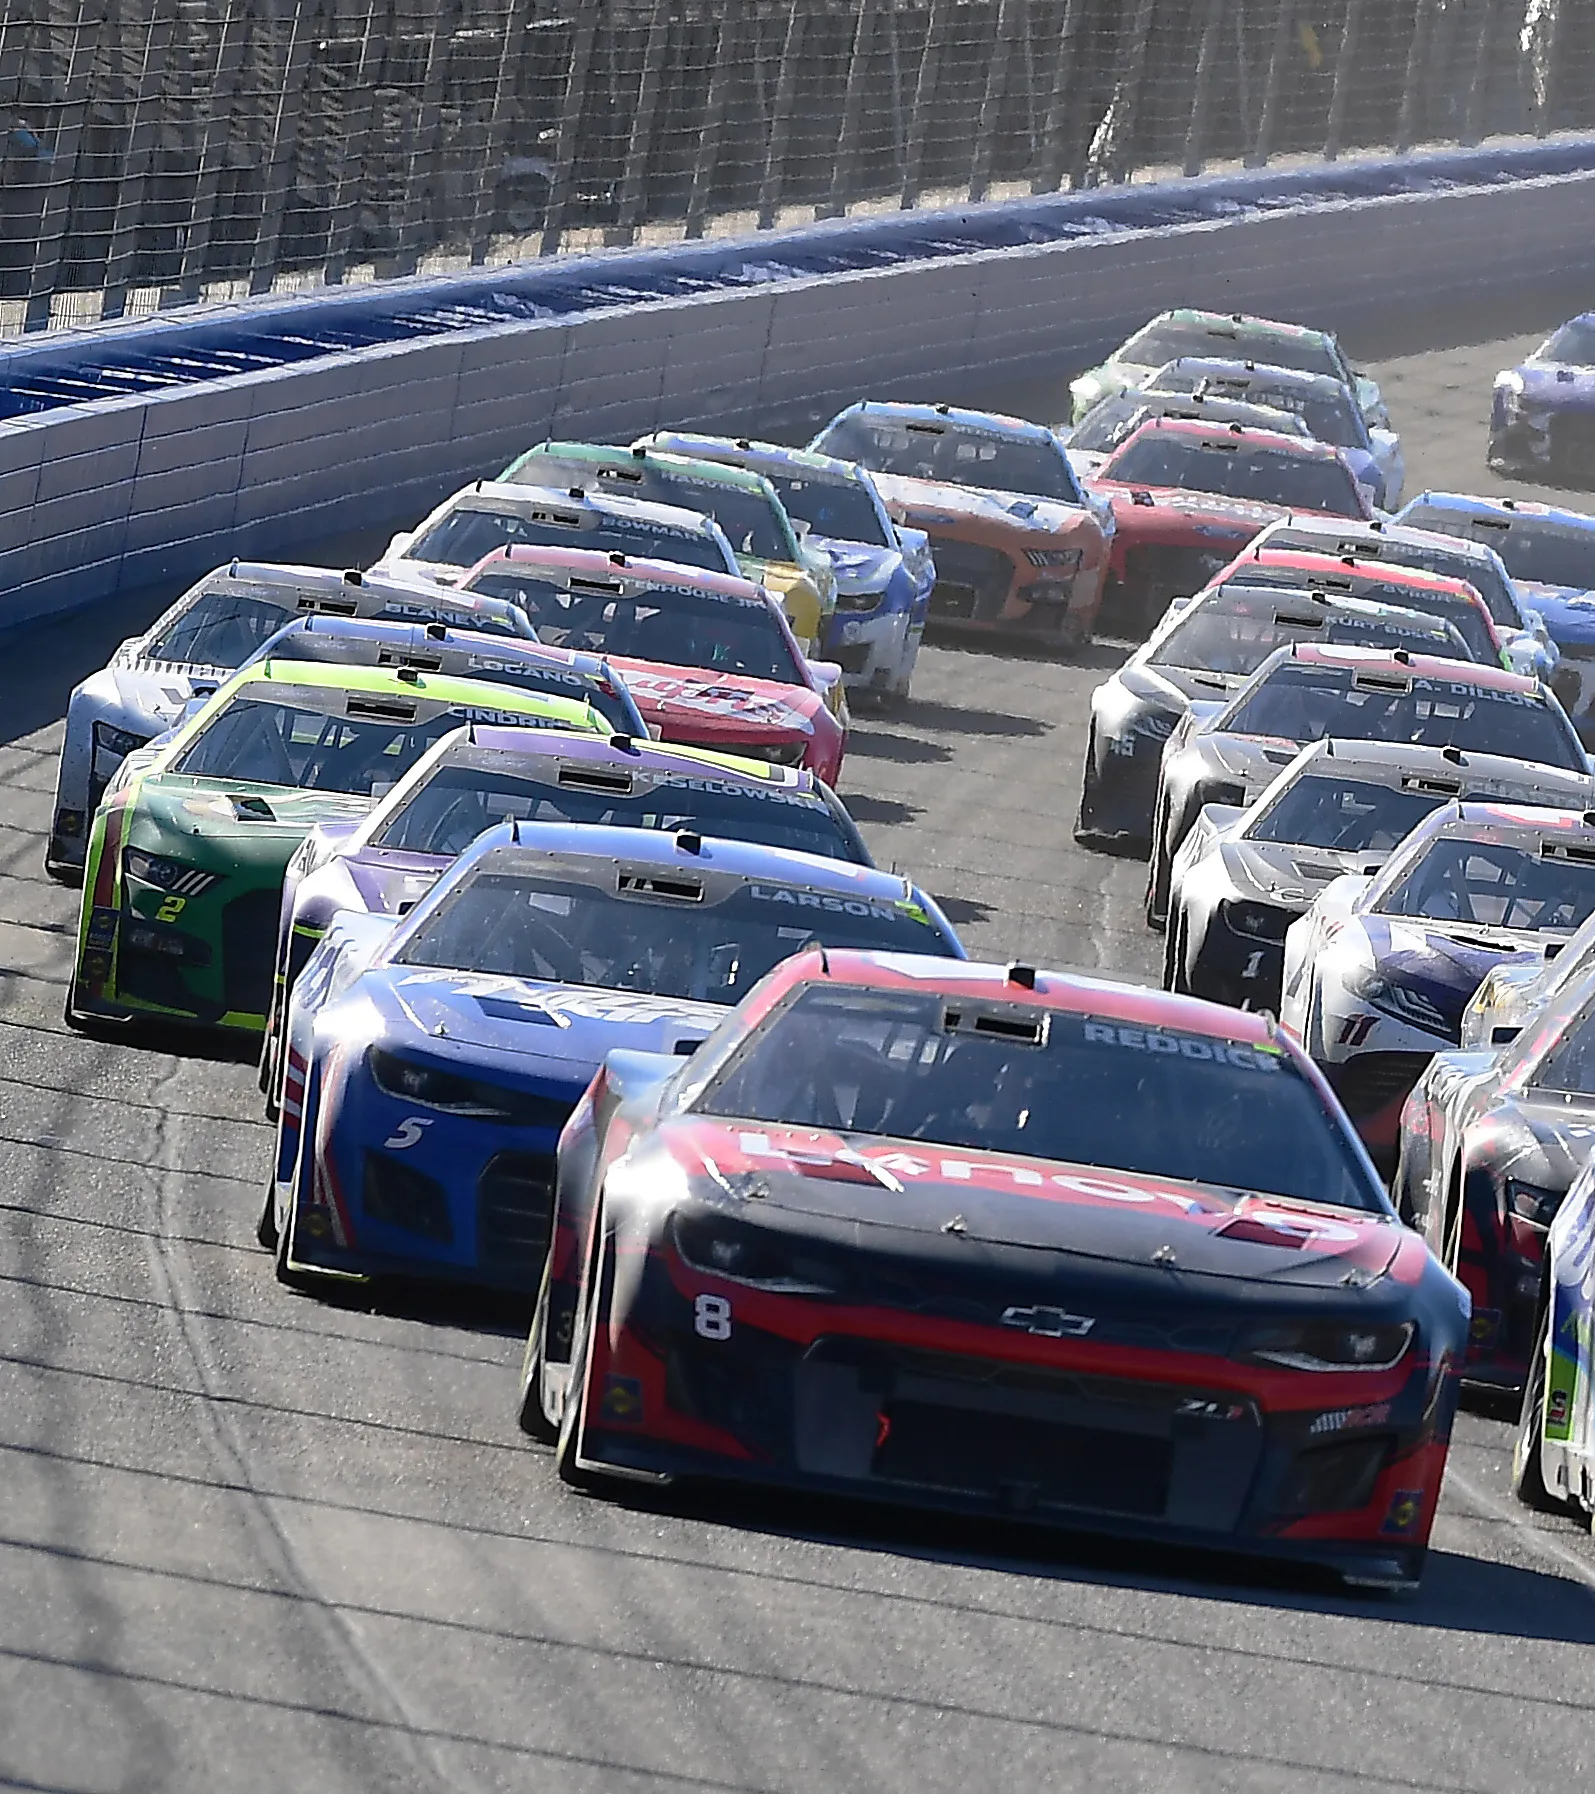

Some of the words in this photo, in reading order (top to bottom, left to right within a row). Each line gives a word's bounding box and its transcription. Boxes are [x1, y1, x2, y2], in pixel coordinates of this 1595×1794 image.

[384, 602, 490, 628] BLANEY
[467, 656, 582, 687] LOGANO
[154, 895, 188, 923] 2
[751, 886, 896, 923] LARSON
[1241, 950, 1265, 980] 1
[383, 1115, 434, 1150] 5
[694, 1293, 733, 1341] 8
